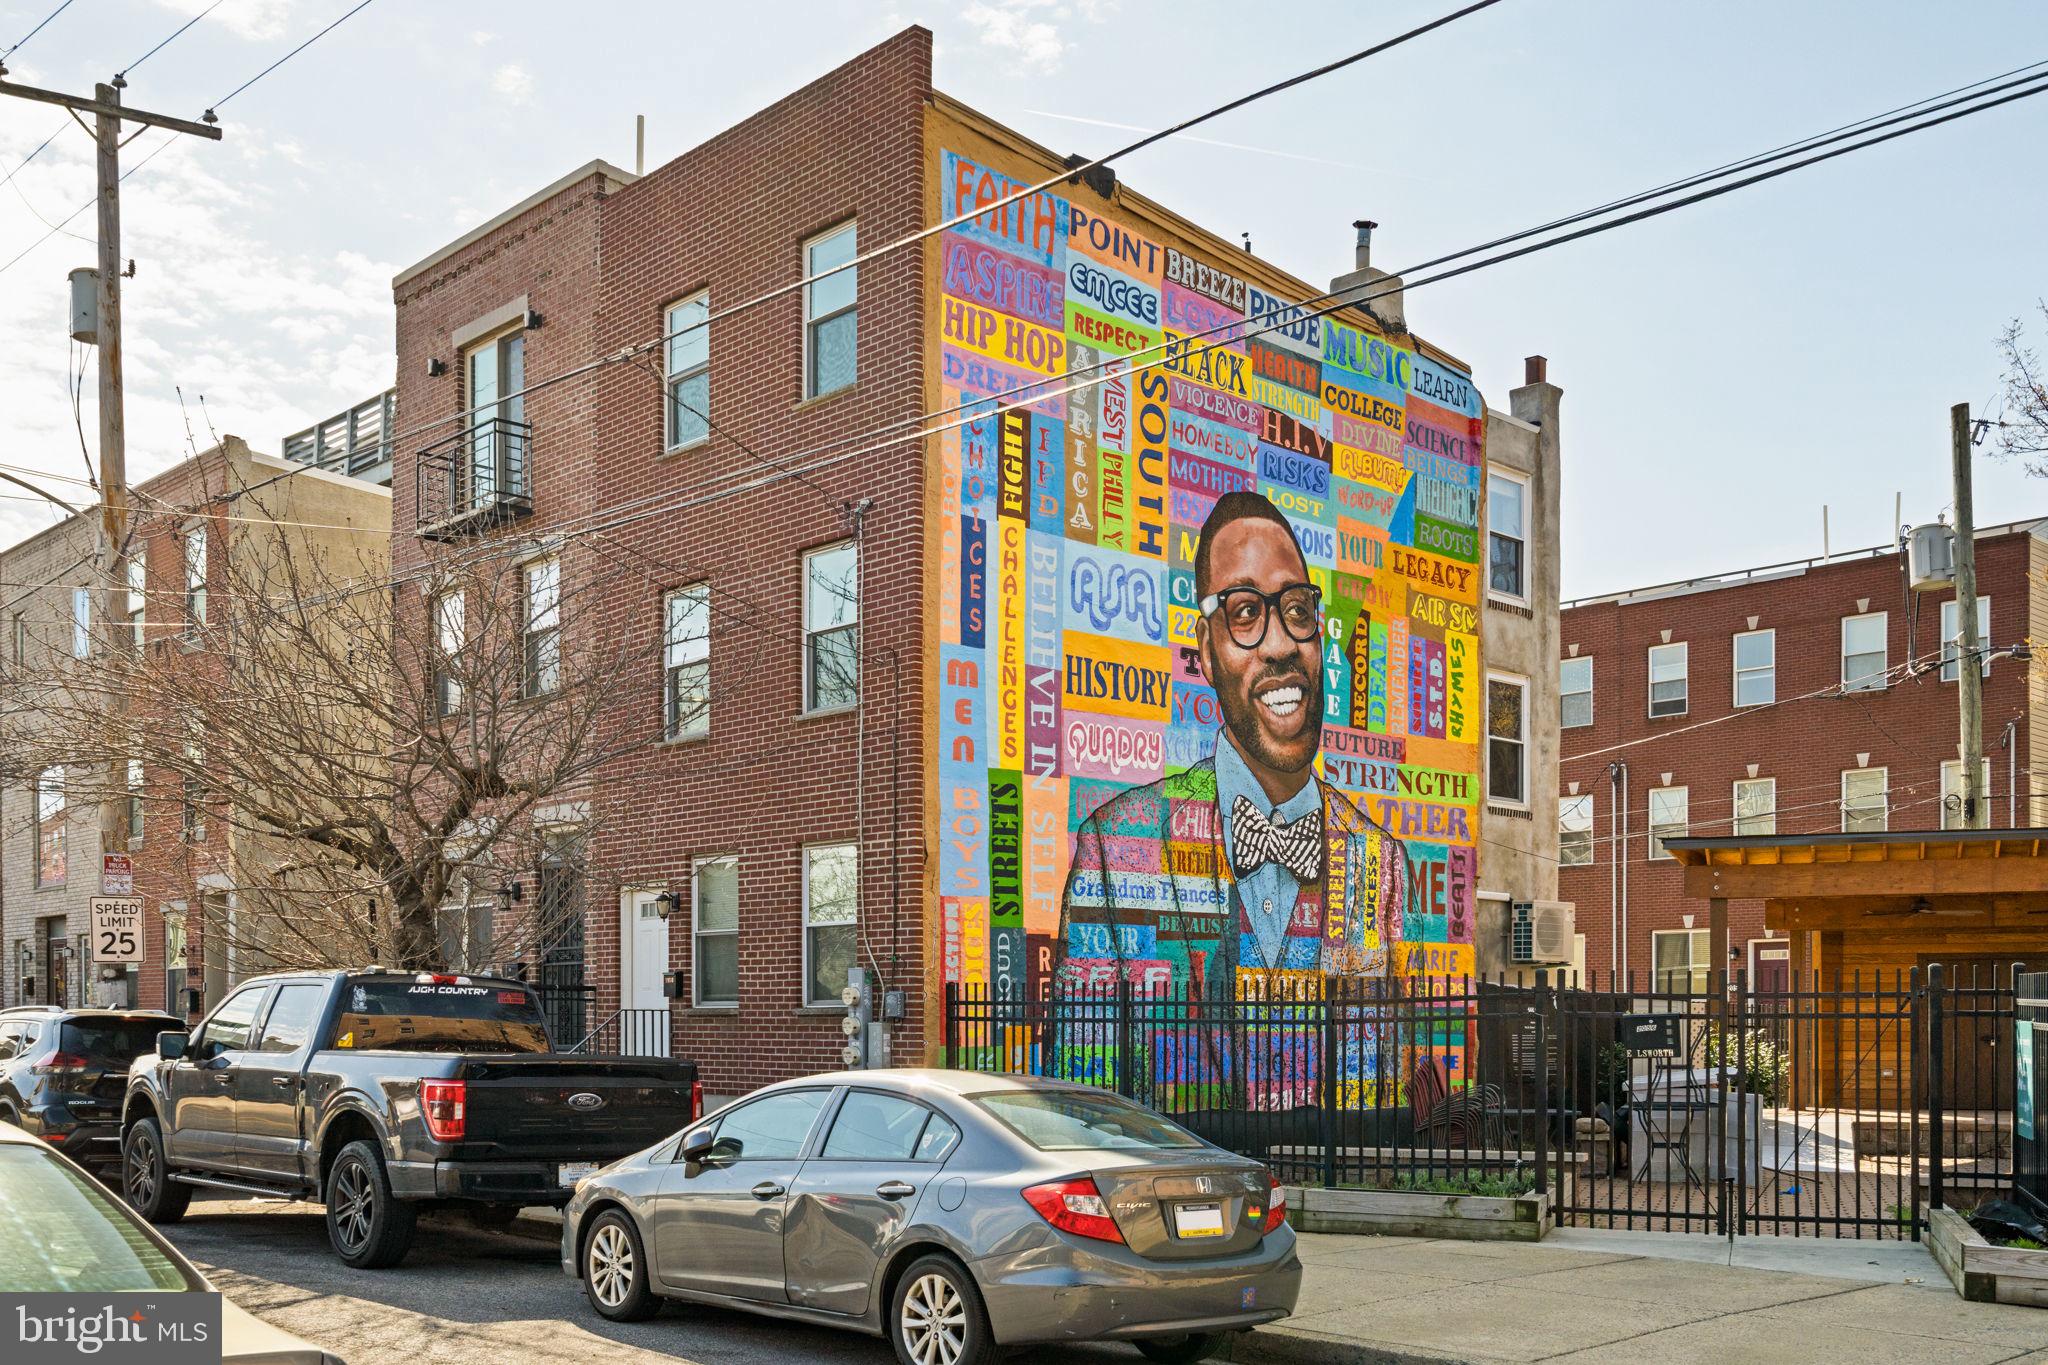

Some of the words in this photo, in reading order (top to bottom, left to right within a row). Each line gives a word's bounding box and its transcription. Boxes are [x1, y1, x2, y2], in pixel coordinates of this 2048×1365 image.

[955, 159, 1057, 255] FAITH
[1069, 206, 1161, 273] POINT
[944, 244, 1065, 329] ASPIRE
[1166, 248, 1244, 311] BREEZE
[944, 298, 997, 350] HIP
[1004, 319, 1064, 374] HOP
[1074, 311, 1150, 353] RESPECT
[1249, 288, 1321, 349] PRIDE
[1163, 330, 1248, 396] BLACK
[1323, 319, 1411, 391] MUSIC
[1173, 381, 1259, 426] VIOLENCE
[1252, 379, 1321, 424] STRENGTH
[1324, 385, 1402, 431] COLLEGE
[1414, 367, 1468, 409] LEARN
[1003, 410, 1024, 514] FIGHT
[1069, 345, 1094, 531] AFRICA
[1138, 370, 1169, 557] SOUTH
[1171, 421, 1259, 465] HOMEBOY
[1341, 419, 1401, 459] DIVINE
[1171, 456, 1254, 493] MOTHERS
[1263, 451, 1327, 494] RISKS
[1407, 450, 1468, 484] BEINGS
[1102, 450, 1125, 551] PHILLY
[1266, 487, 1324, 518] LOST
[1339, 531, 1384, 570] YOUR
[1419, 522, 1473, 557] ROOTS
[1337, 575, 1394, 609] GROW
[1393, 549, 1472, 593] LEGACY
[1002, 526, 1019, 759] CHALLENGES
[1030, 541, 1058, 728] BELIEVE
[1065, 653, 1172, 709] HISTORY
[1327, 616, 1343, 717] GAVE
[1353, 616, 1369, 730] RECORD
[1369, 632, 1388, 727] DEAL
[1391, 617, 1406, 736] REMEMBER
[1428, 650, 1445, 730] S.T.D.
[1449, 637, 1466, 739] RHYMES
[1030, 743, 1057, 794] IN
[1322, 728, 1404, 760] FUTURE
[1323, 756, 1468, 799] STRENGTH
[952, 787, 982, 890] BOYS
[992, 782, 1019, 917] STREETS
[1030, 809, 1057, 914] SELF
[95, 903, 138, 914] SPEED
[1071, 875, 1156, 901] Grandma
[1407, 858, 1446, 916] ME
[100, 917, 135, 927] LIMIT
[100, 932, 136, 955] 25
[437, 986, 489, 996] COUNTRY
